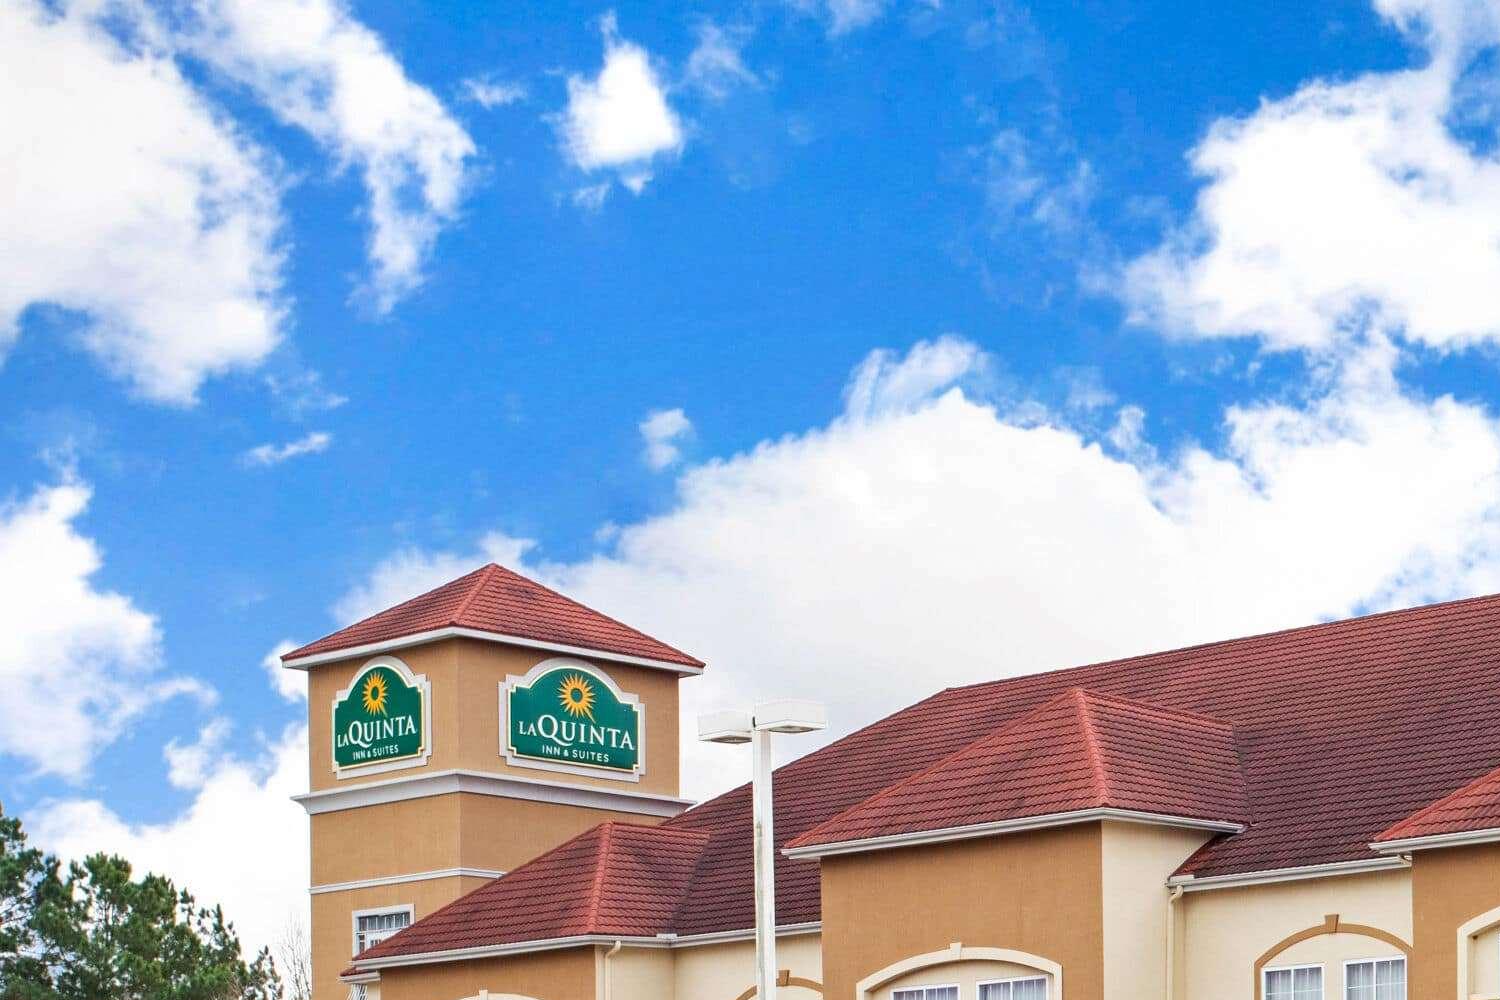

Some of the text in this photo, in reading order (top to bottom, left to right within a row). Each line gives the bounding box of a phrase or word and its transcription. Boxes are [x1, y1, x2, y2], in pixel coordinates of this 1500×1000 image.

[337, 715, 417, 748] LA QUINTA
[519, 714, 635, 750] LA QUINTA
[353, 744, 399, 760] INN & SUITES
[542, 744, 610, 763] INN & SUITES
